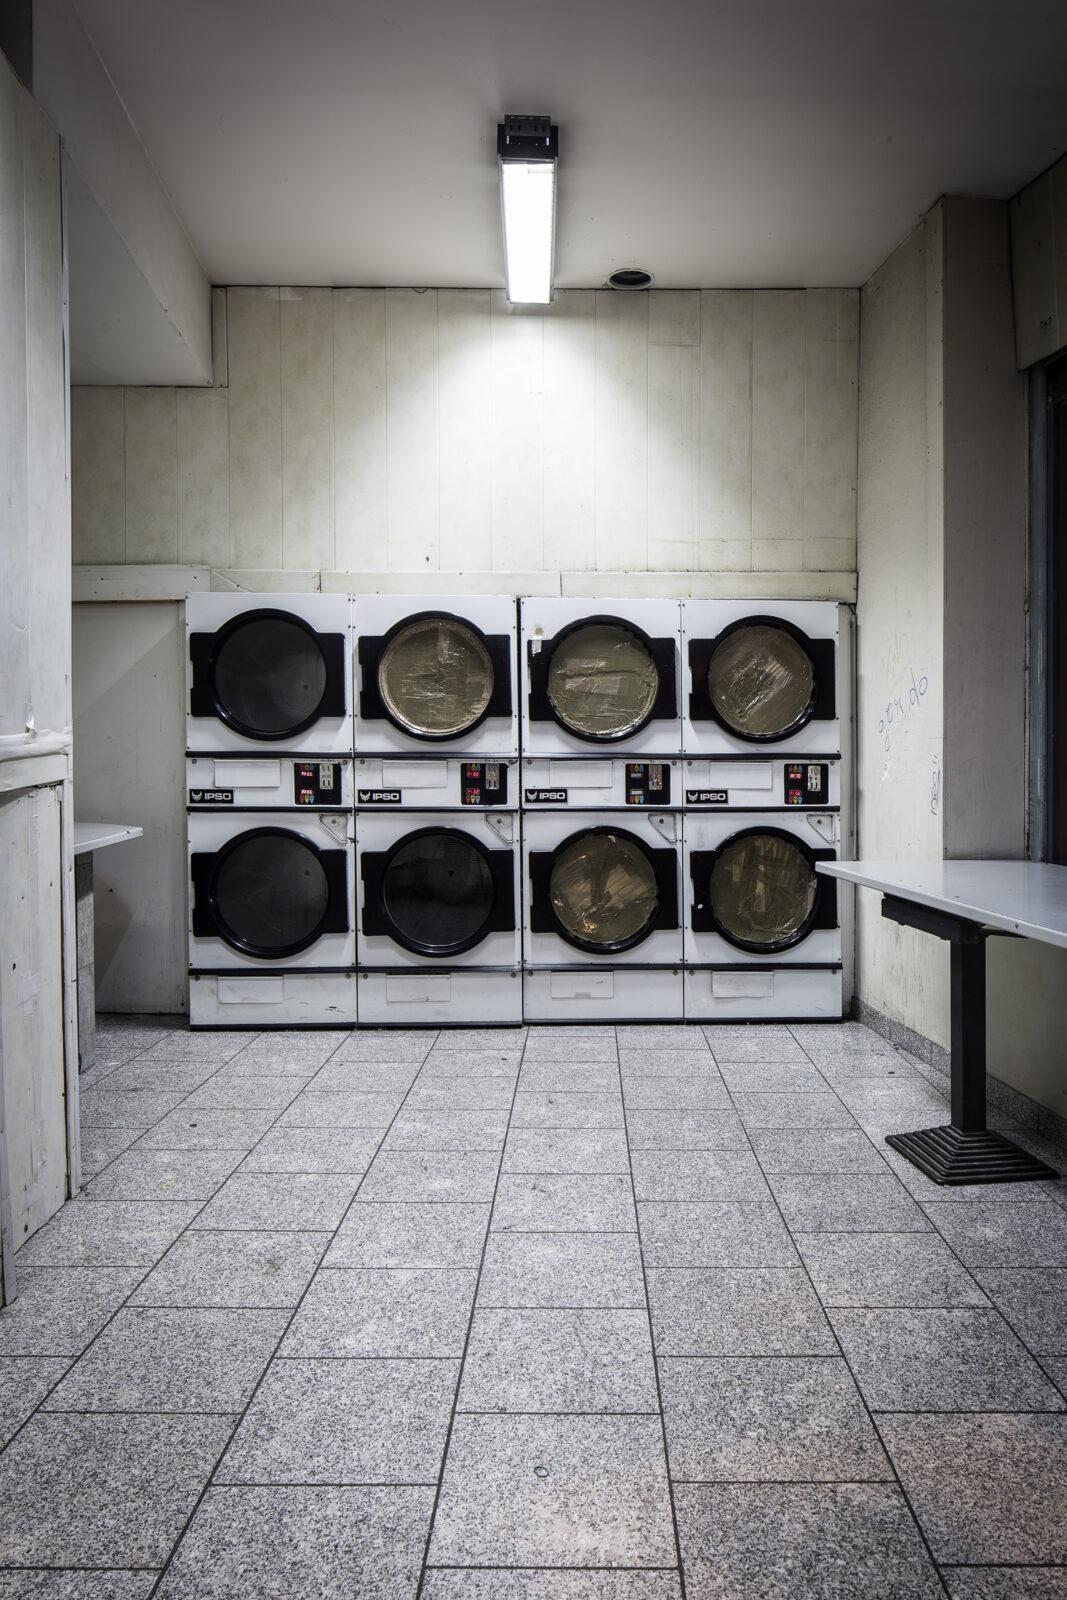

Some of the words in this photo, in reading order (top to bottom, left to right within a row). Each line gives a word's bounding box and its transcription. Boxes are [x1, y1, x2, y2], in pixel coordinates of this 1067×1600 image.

[204, 792, 232, 800] IPSO
[372, 792, 400, 801] IPSO
[539, 792, 566, 800] IPSO
[699, 793, 726, 801] IPSO
